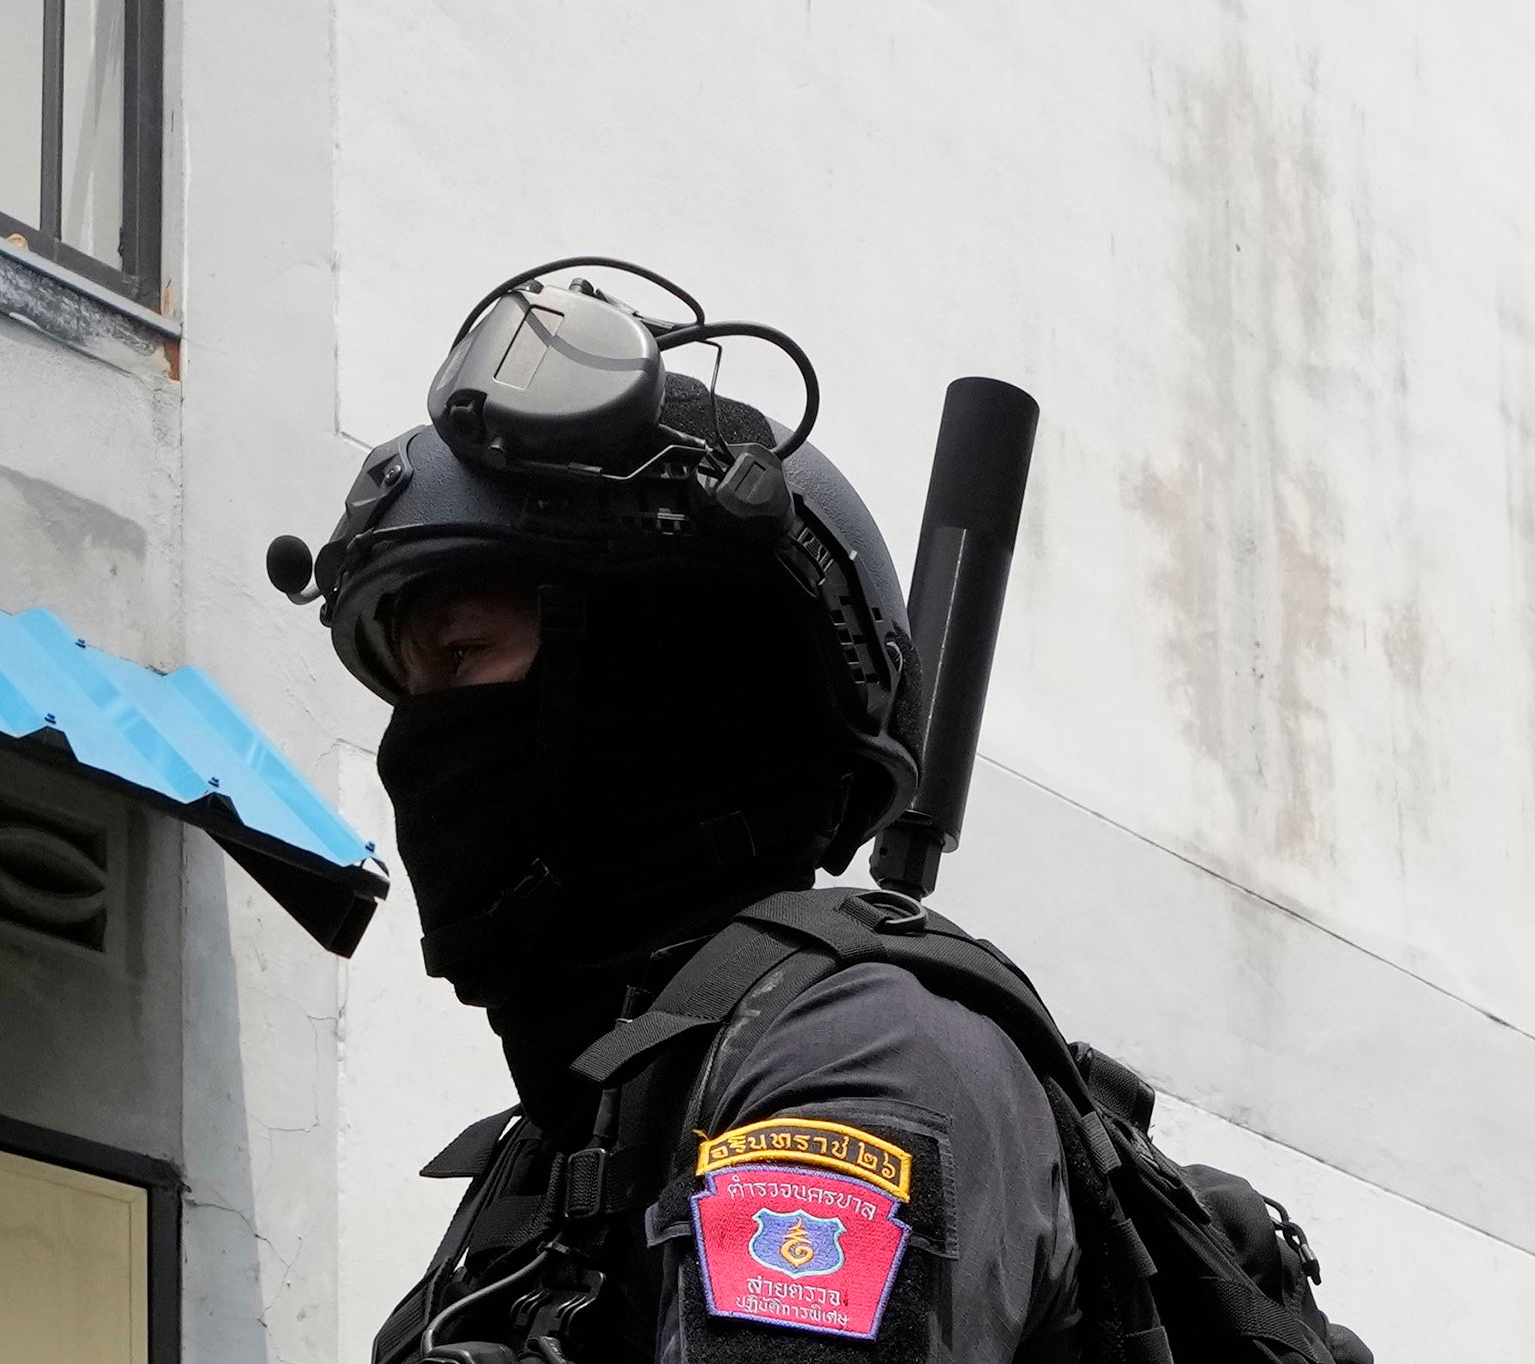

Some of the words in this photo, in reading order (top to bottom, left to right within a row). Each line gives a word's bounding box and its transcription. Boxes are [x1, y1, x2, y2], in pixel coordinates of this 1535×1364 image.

[710, 1131, 850, 1160] อรินทราช
[857, 1141, 898, 1179] ๒๖
[727, 1176, 877, 1220] ตำรวจนครบาล
